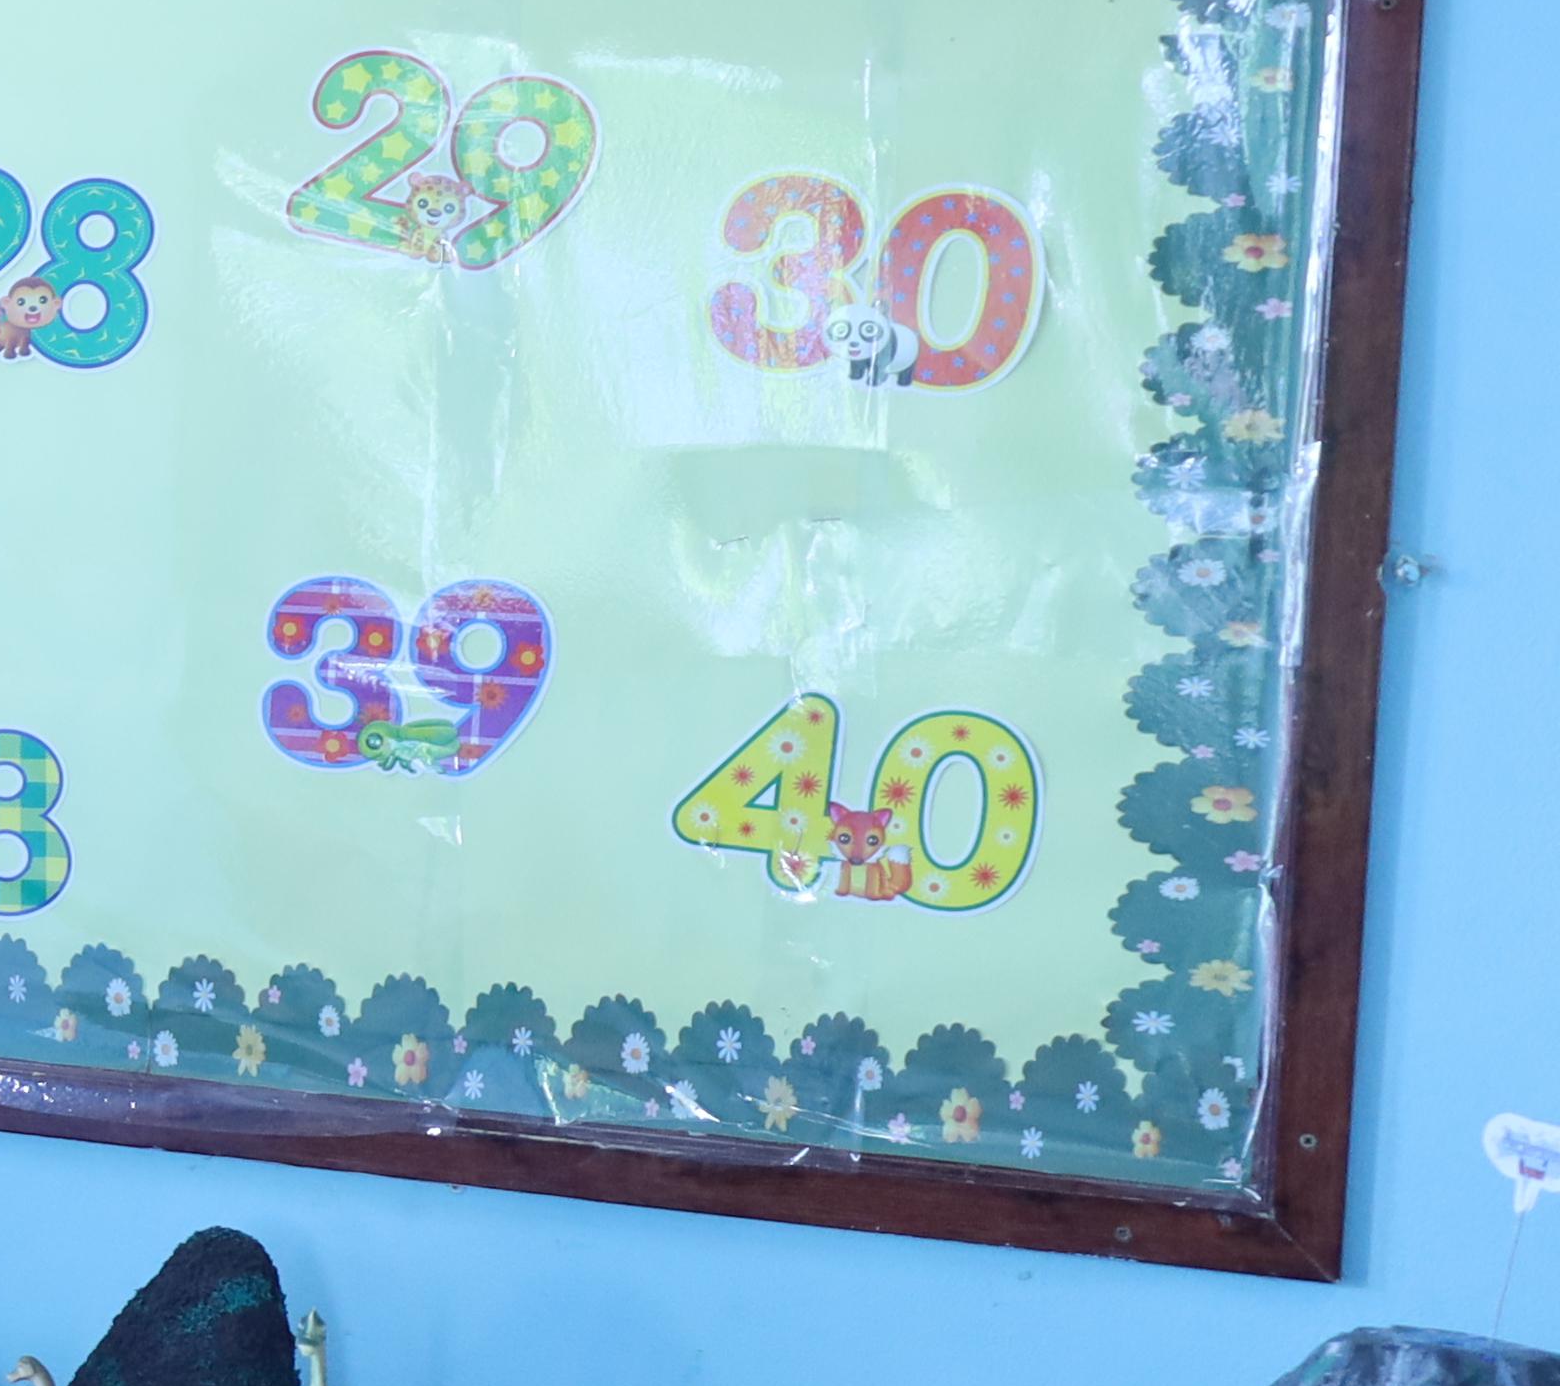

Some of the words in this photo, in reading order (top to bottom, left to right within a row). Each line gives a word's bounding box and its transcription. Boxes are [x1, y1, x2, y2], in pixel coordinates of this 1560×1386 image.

[287, 49, 597, 271] 29
[711, 171, 1044, 391] 30
[261, 574, 553, 778] 39
[672, 690, 1043, 912] 40
